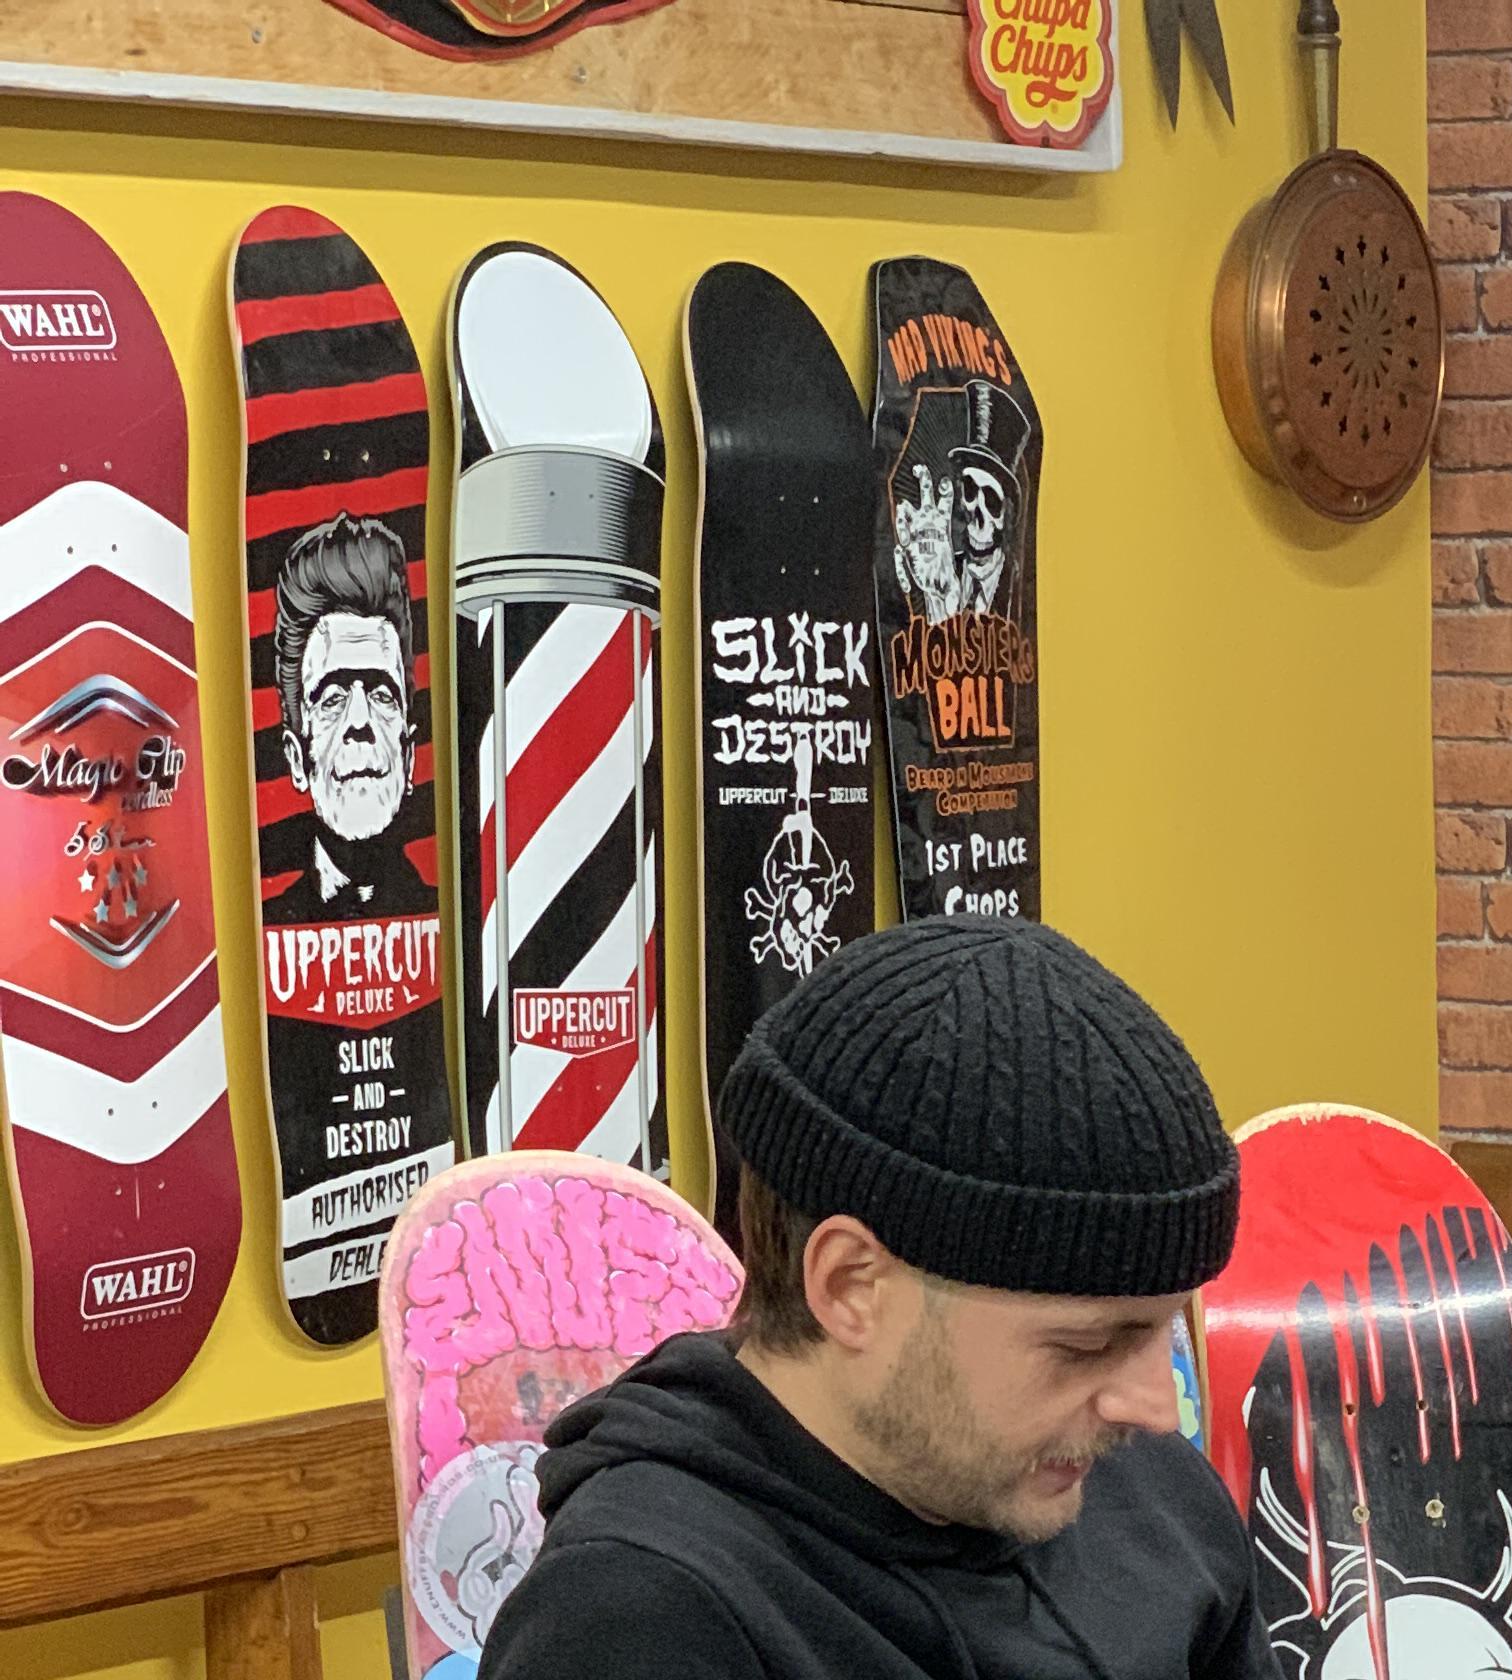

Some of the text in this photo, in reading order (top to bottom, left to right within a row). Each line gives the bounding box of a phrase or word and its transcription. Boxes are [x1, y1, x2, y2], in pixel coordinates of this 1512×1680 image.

[991, 24, 1088, 108] Chups
[0, 303, 105, 337] WAHL
[12, 352, 118, 363] PROFESSIONAL
[888, 319, 928, 385] MAD
[711, 611, 870, 689] SLICK
[892, 611, 1034, 698] MONSTERS
[775, 684, 826, 716] AND
[936, 675, 1011, 740] BALL
[711, 714, 871, 766] DESTROY
[1, 736, 186, 802] Magic Clip
[719, 787, 788, 805] UPPERCUT
[925, 833, 1028, 877] 1ST PLACE
[267, 918, 440, 1002] UPPERCUT
[336, 986, 394, 1016] DELUXE
[520, 997, 630, 1040] UPPERCUT
[339, 1036, 394, 1075] SLICK
[562, 1035, 596, 1048] DELUXE
[326, 1115, 412, 1160] DESTROY
[311, 1160, 430, 1230] AUTHORISED
[329, 1240, 387, 1283] DEALE
[92, 1262, 187, 1306] WAHL
